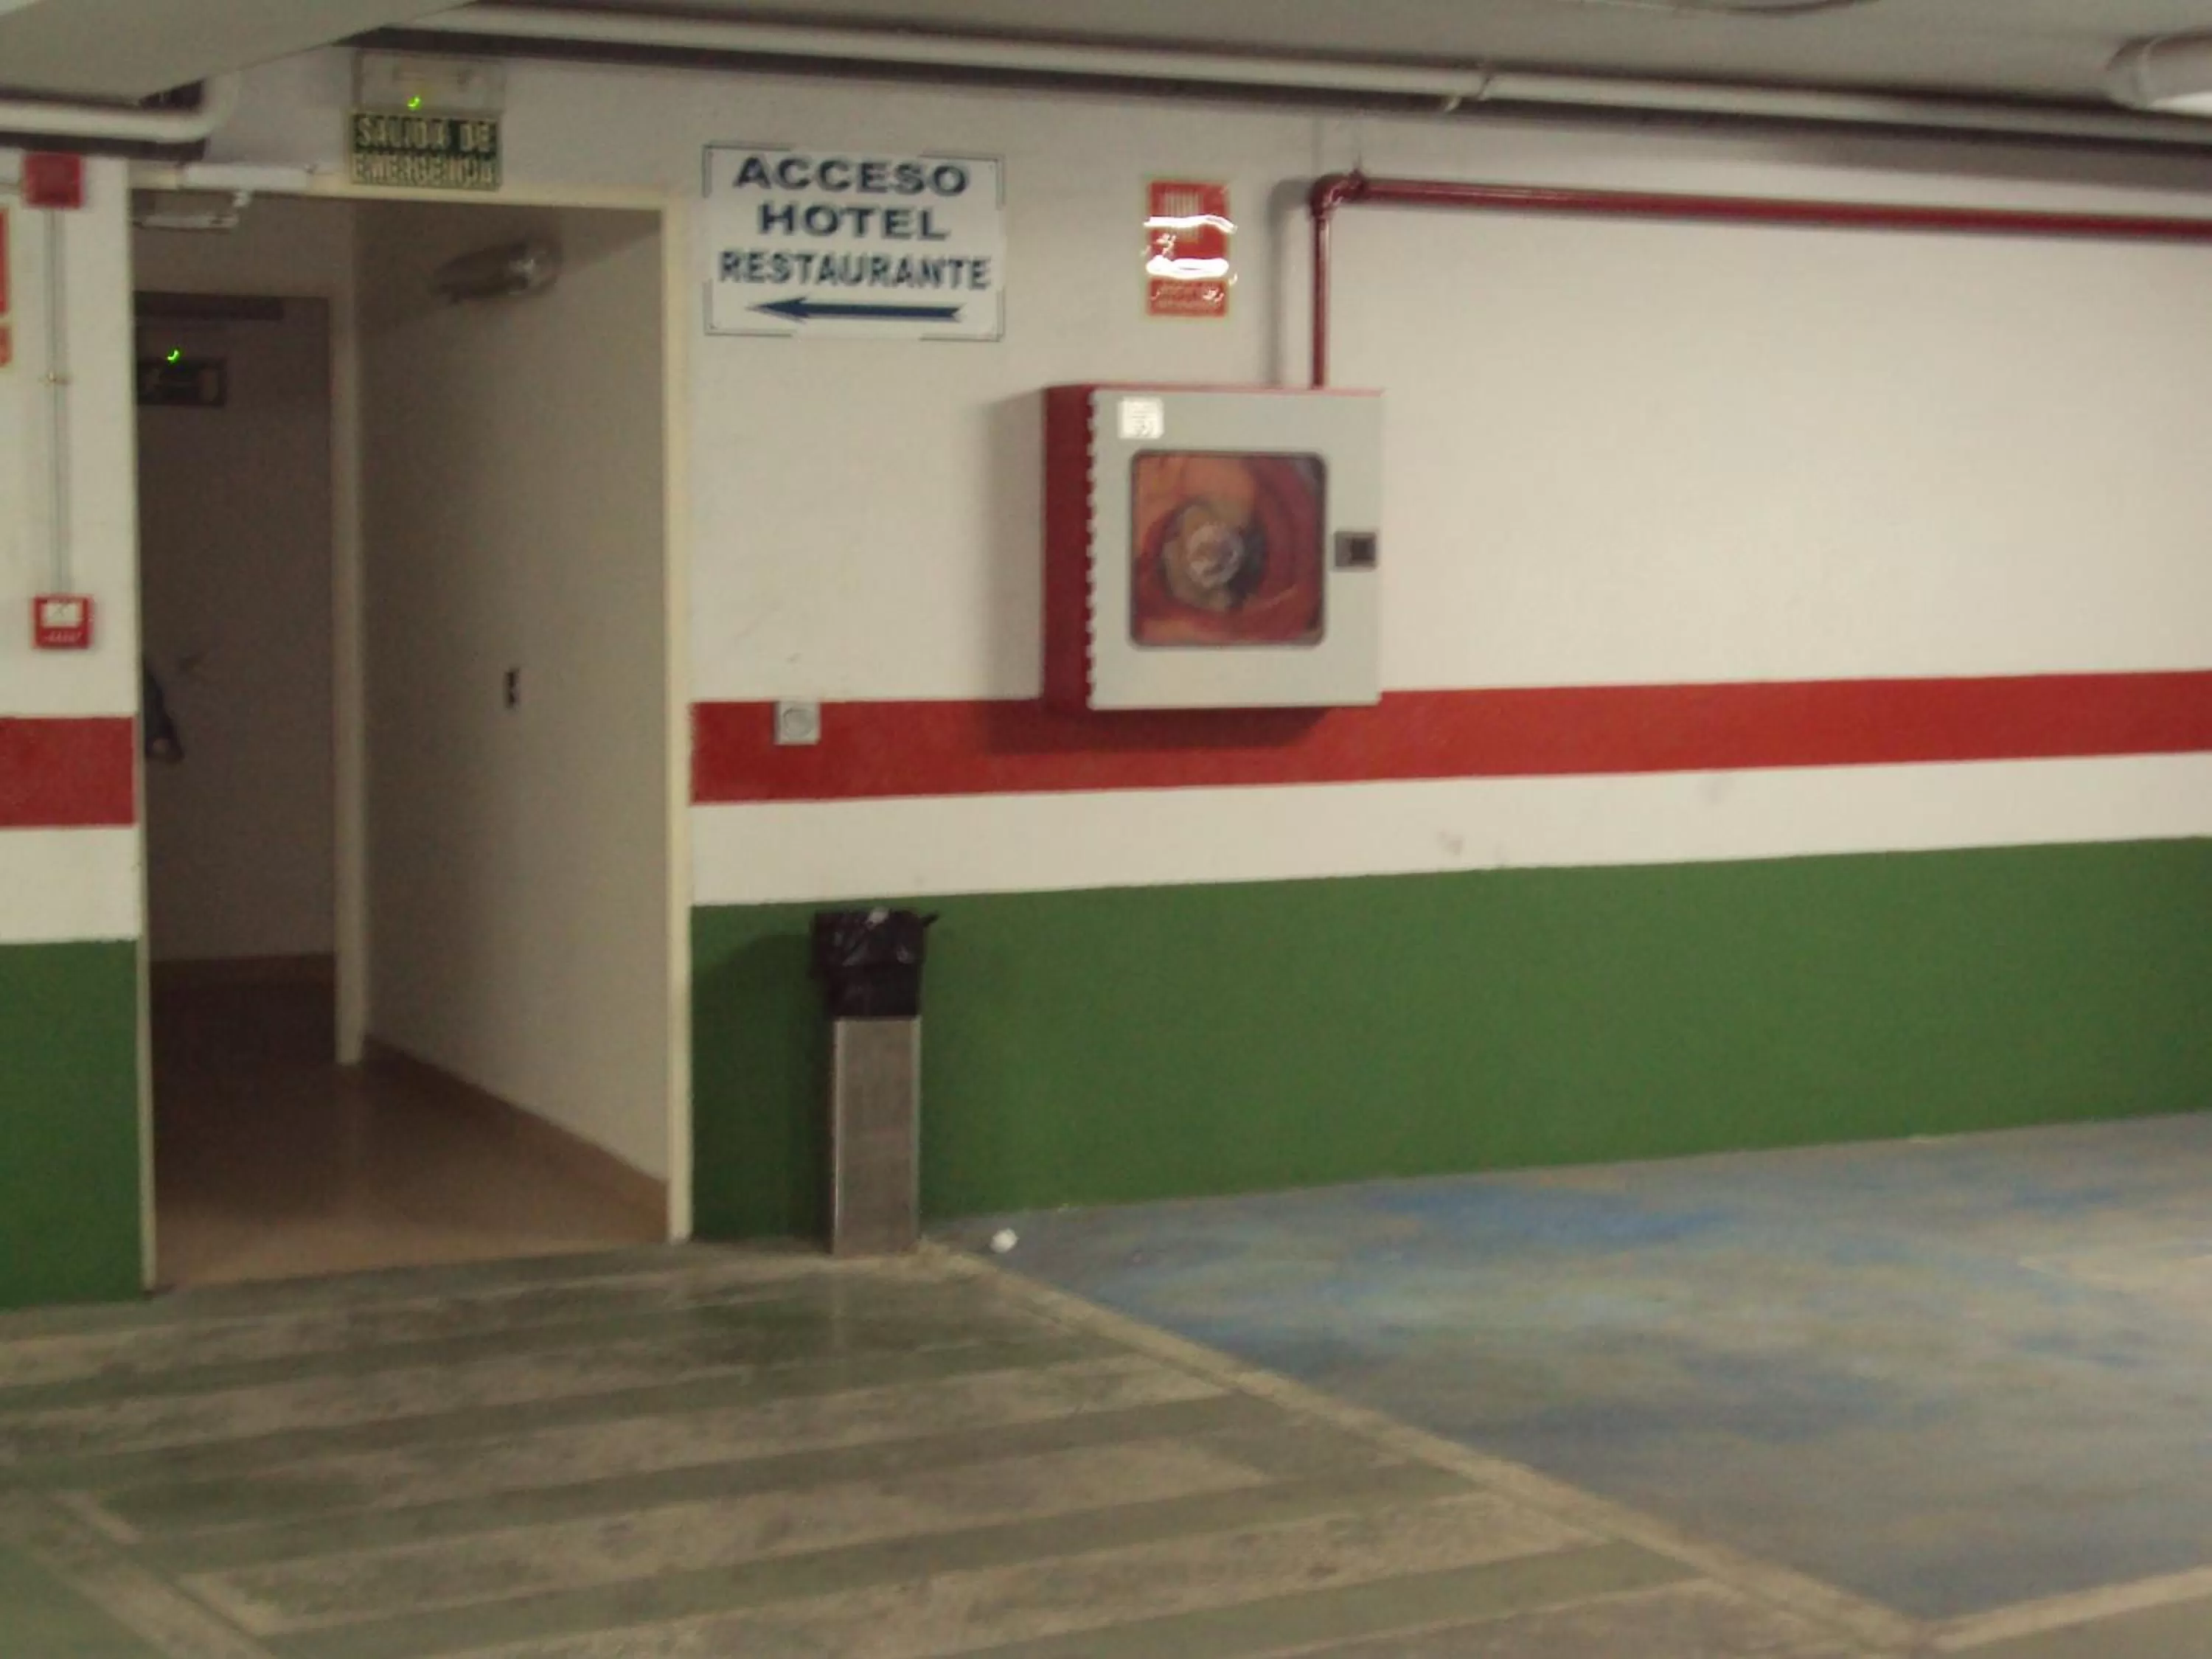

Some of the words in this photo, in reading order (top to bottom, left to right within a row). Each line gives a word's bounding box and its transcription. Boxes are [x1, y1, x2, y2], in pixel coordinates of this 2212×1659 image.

[356, 116, 449, 149] SALIDA
[459, 121, 492, 153] DE
[732, 155, 969, 197] ACCESO
[757, 200, 950, 240] HOTEL
[718, 250, 991, 290] RESTAURANTE
